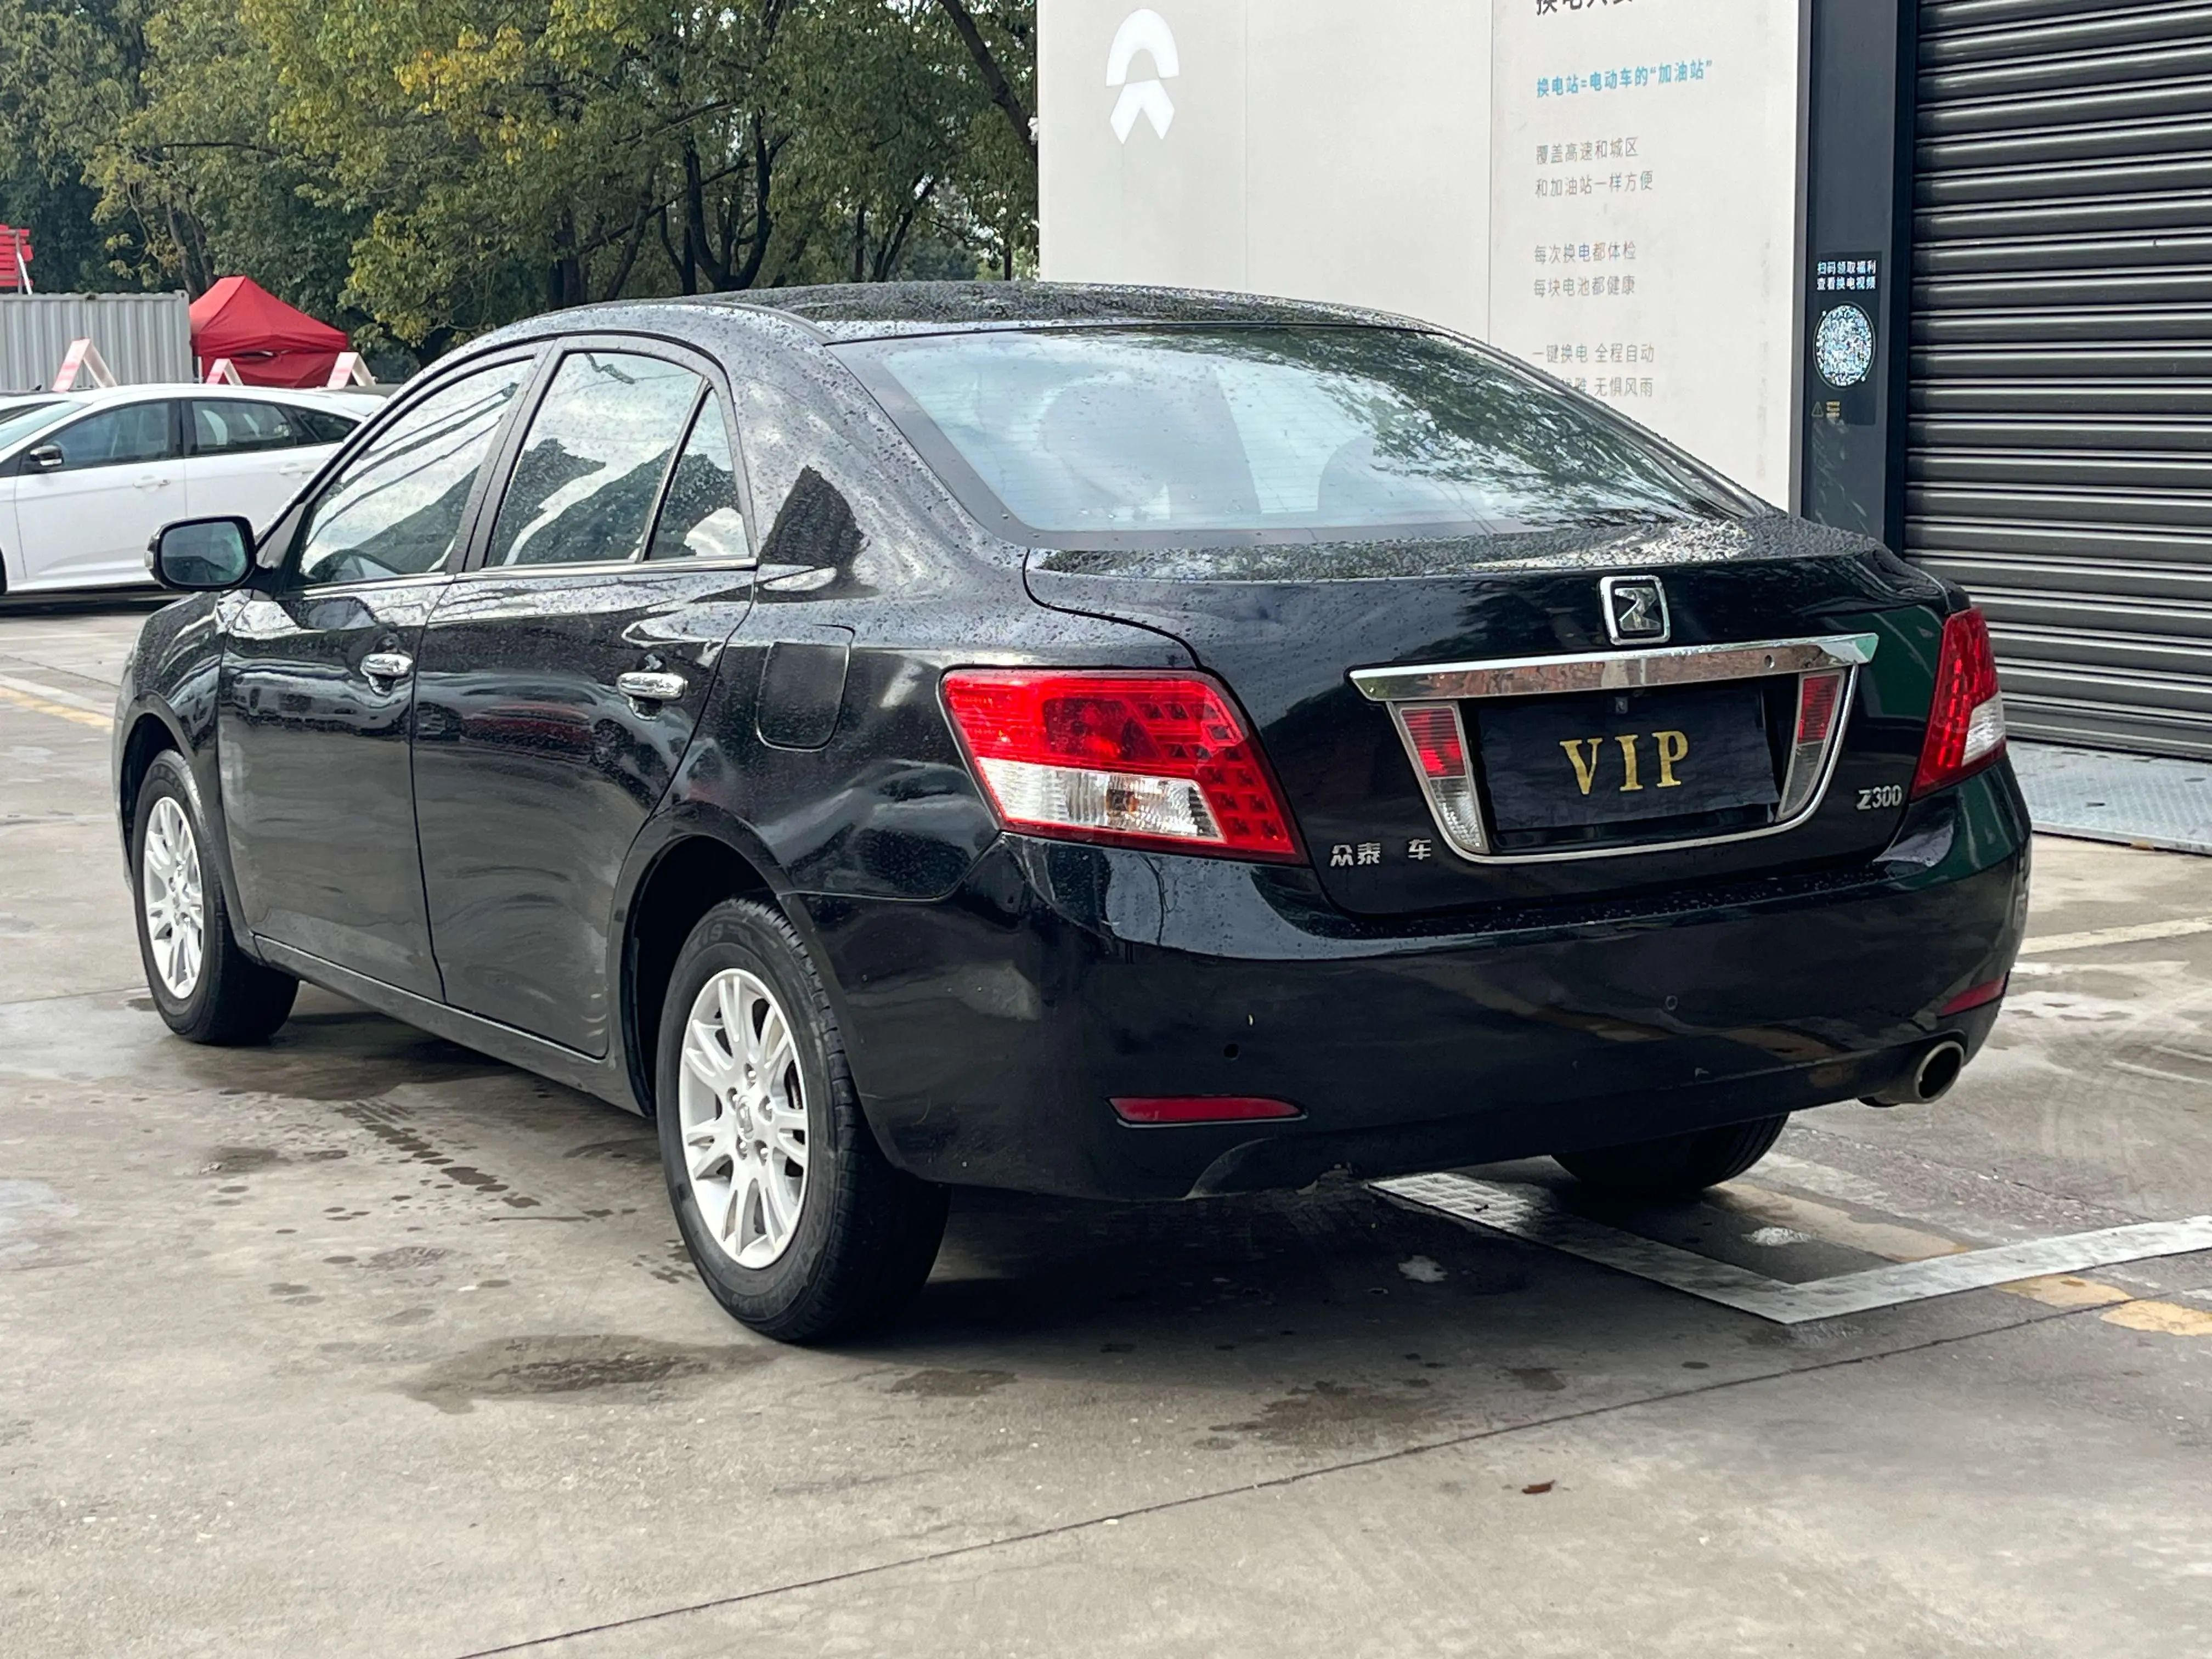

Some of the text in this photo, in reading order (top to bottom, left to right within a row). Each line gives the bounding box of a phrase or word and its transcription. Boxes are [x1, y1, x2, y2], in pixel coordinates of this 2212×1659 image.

[1537, 59, 1712, 98] 换电站=电动车的“加油站”
[1536, 137, 1639, 165] 覆盖高速和城区
[1535, 171, 1653, 198] 和加油站一样方便
[1534, 240, 1636, 264] 每次换电都体检
[1533, 274, 1635, 297] 每块电池都健康
[1816, 275, 1876, 291] 查看换电视频
[1532, 343, 1655, 364] 一键换电 全程自动
[1594, 377, 1653, 398] 无惧风雨
[1559, 731, 1689, 795] VIP
[1856, 785, 1903, 810] Z300
[1330, 839, 1432, 867] 众泰 车
